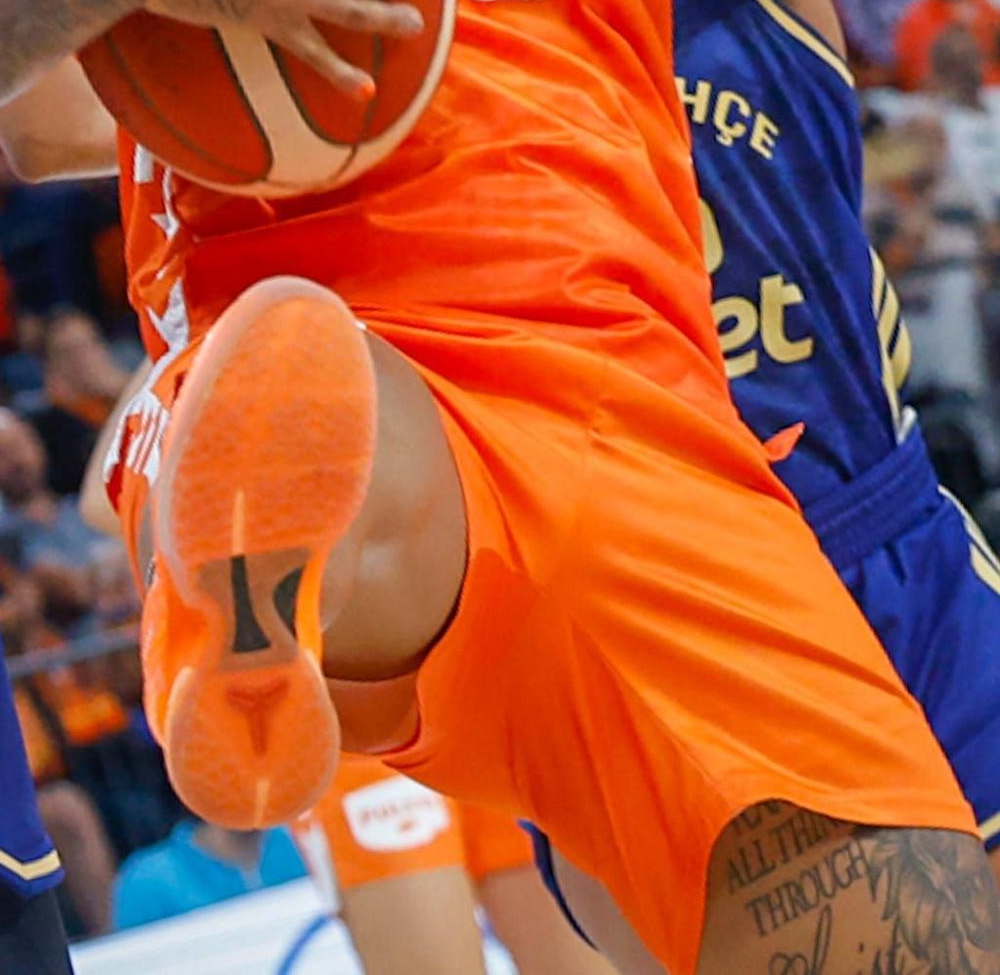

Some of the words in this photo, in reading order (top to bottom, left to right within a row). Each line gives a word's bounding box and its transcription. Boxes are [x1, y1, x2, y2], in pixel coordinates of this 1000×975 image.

[711, 274, 814, 380] et
[726, 838, 777, 894] ALL
[744, 837, 869, 938] THROUGH
